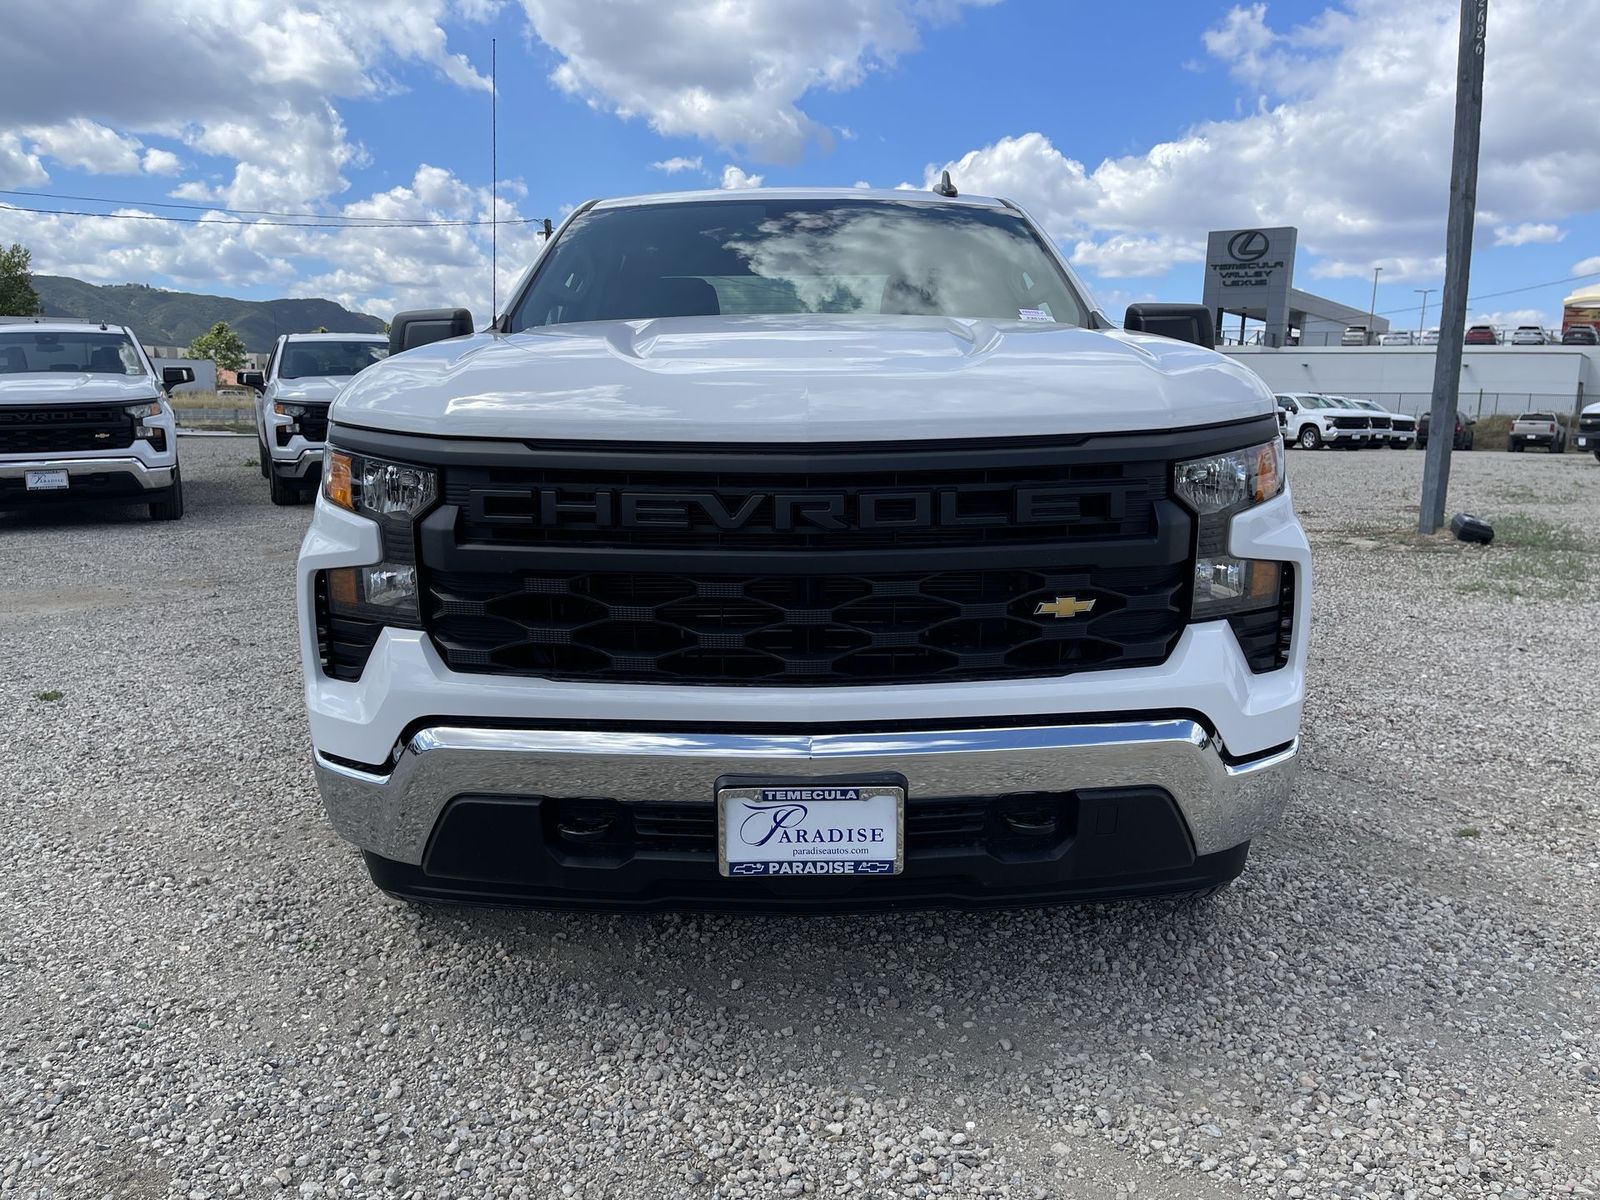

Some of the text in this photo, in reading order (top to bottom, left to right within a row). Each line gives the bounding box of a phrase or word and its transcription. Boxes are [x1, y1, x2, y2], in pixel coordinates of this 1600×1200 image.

[1210, 261, 1284, 271] TEMECULA
[1219, 270, 1273, 278] VALLEY
[1222, 279, 1267, 287] LEXUS
[468, 484, 1148, 531] CHEVROLET
[764, 790, 858, 801] TEMECULA
[740, 803, 885, 847] PARADISE
[792, 847, 870, 857] paradiseautos.com
[768, 862, 855, 874] PARADISE
